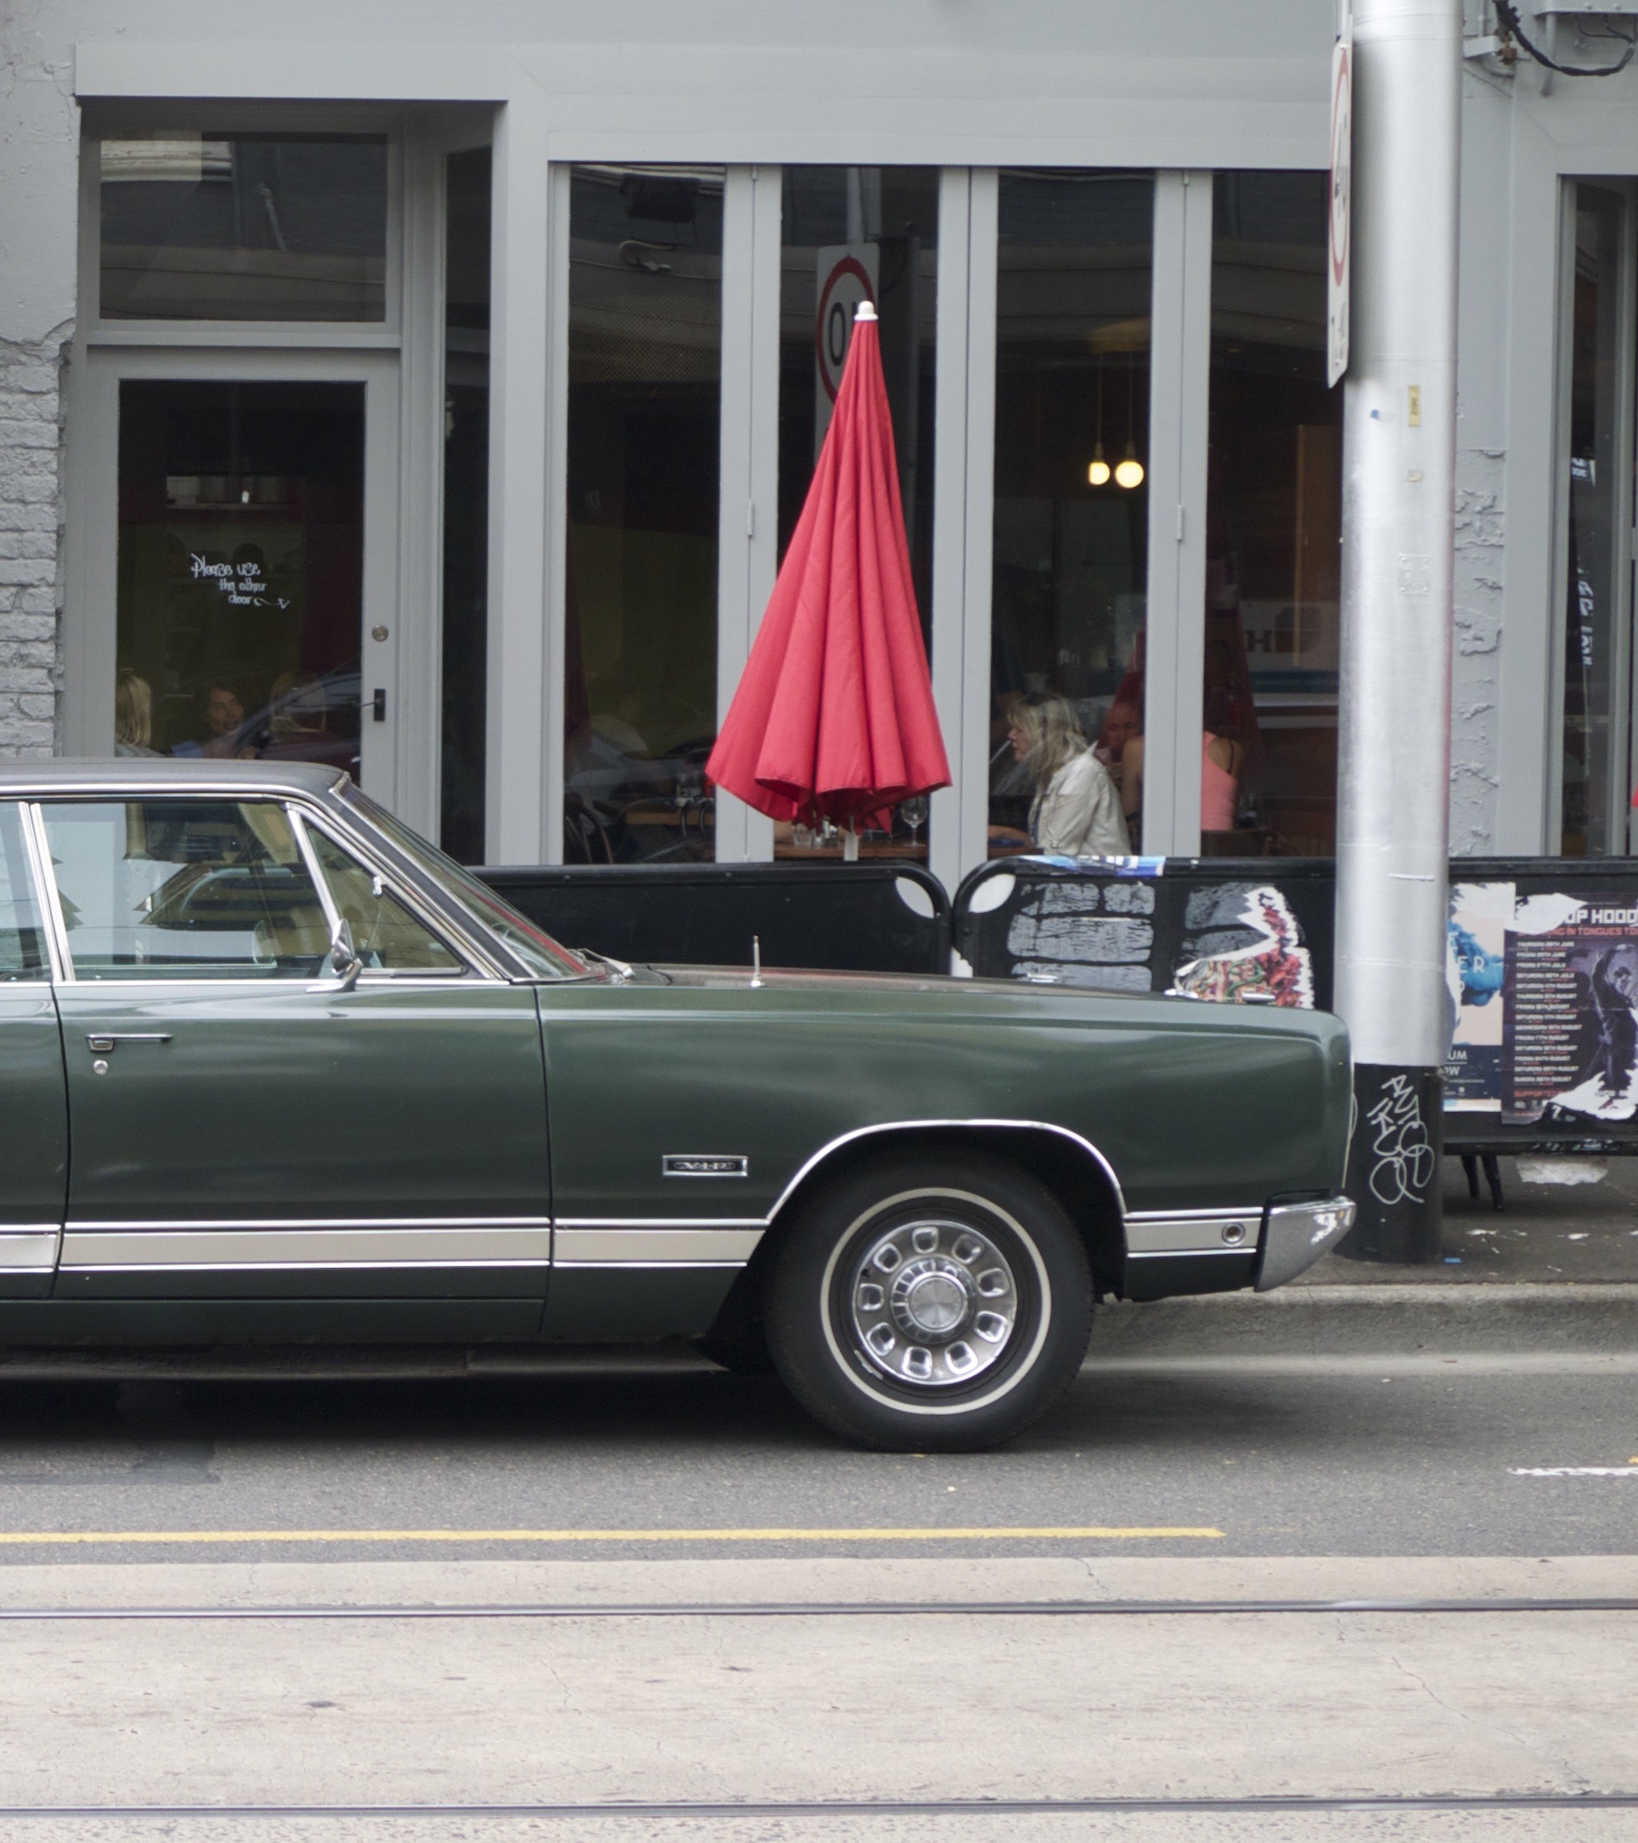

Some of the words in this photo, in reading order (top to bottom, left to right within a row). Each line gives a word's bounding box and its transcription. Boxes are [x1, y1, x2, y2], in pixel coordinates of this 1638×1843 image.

[190, 552, 234, 579] Please
[236, 561, 262, 577] use
[217, 577, 236, 592] the
[238, 577, 268, 593] other
[228, 590, 253, 605] door
